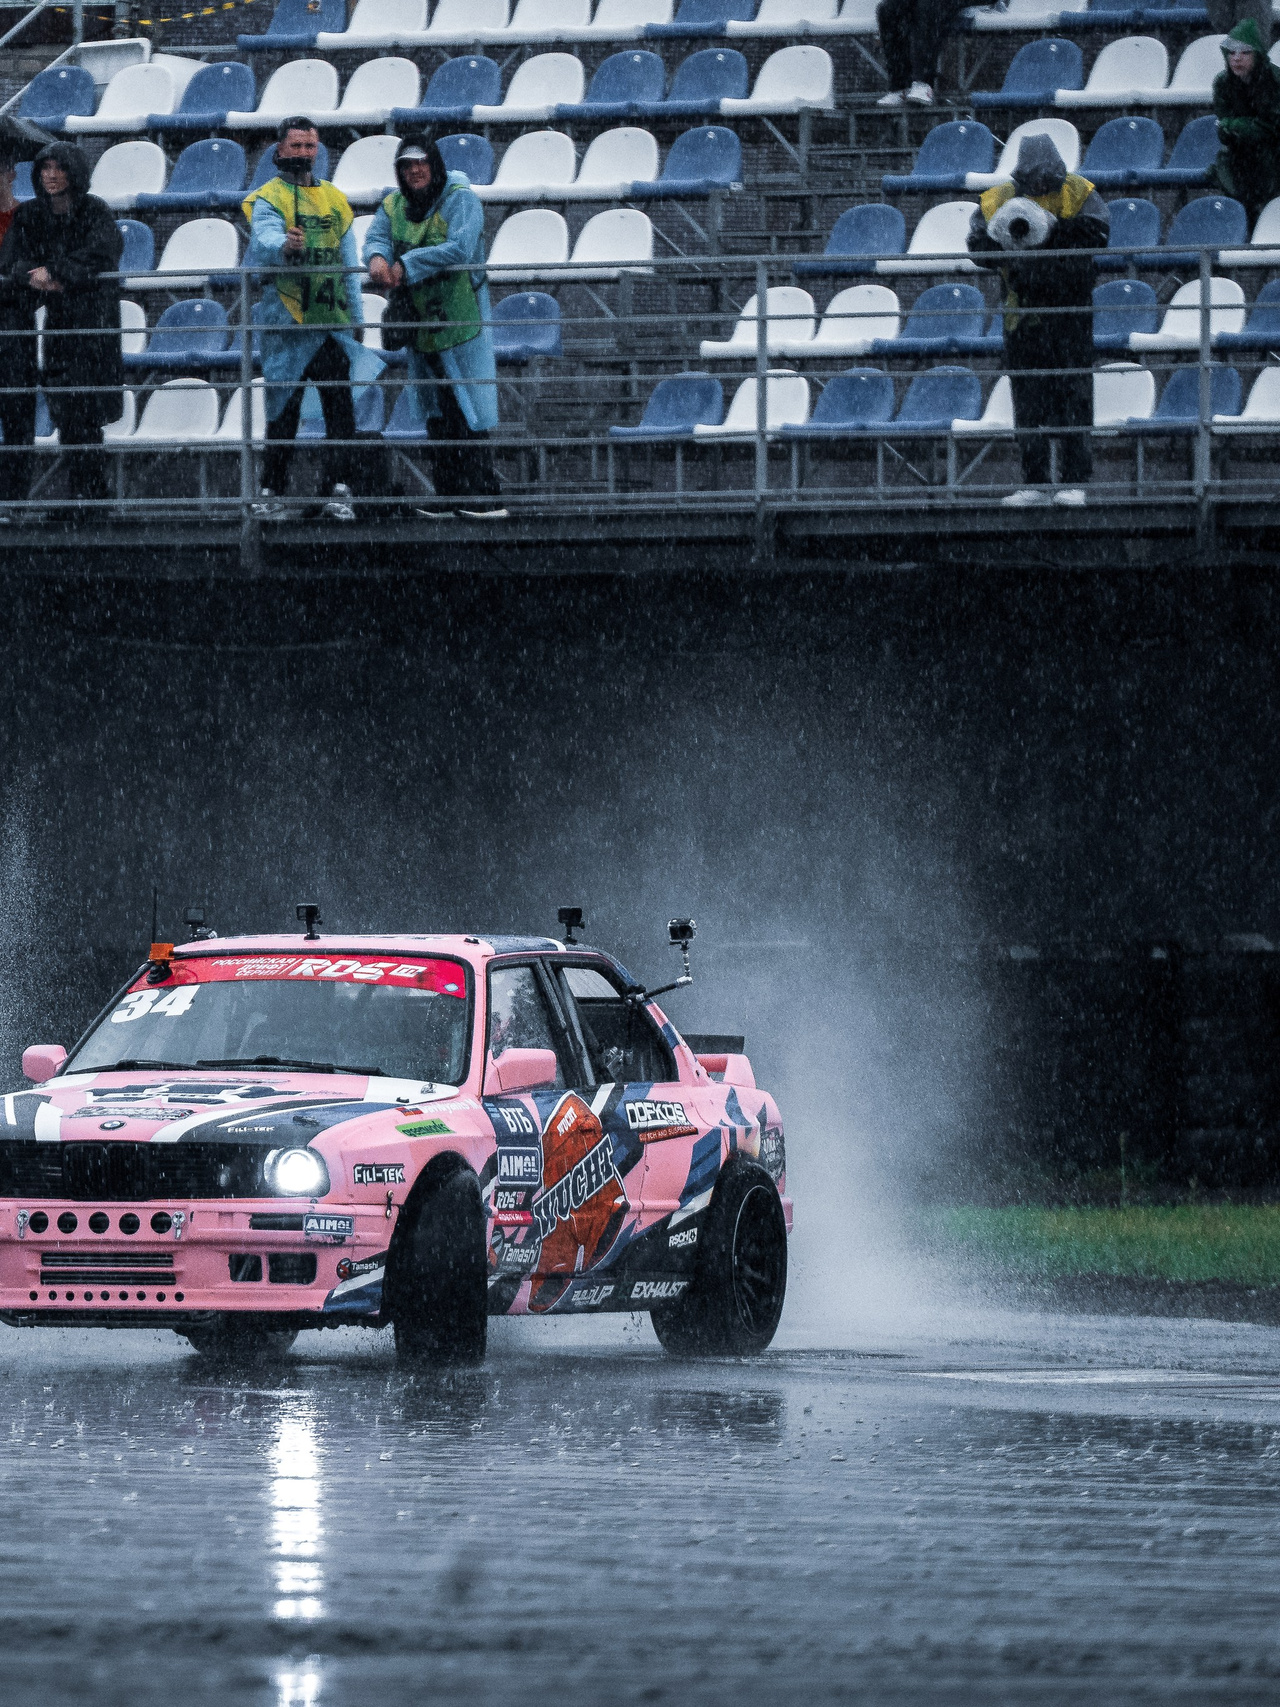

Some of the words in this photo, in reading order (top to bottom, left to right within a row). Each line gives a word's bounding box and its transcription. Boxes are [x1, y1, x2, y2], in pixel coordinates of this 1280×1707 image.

[288, 958, 398, 980] RDS
[111, 985, 201, 1024] 34
[499, 1107, 533, 1133] ВТБ
[354, 1165, 404, 1184] FILI-TEK
[306, 1218, 351, 1231] AIMOL
[502, 1243, 538, 1263] Tamashi
[352, 1261, 379, 1270] Tamashi
[631, 1281, 689, 1298] EXHAUST
